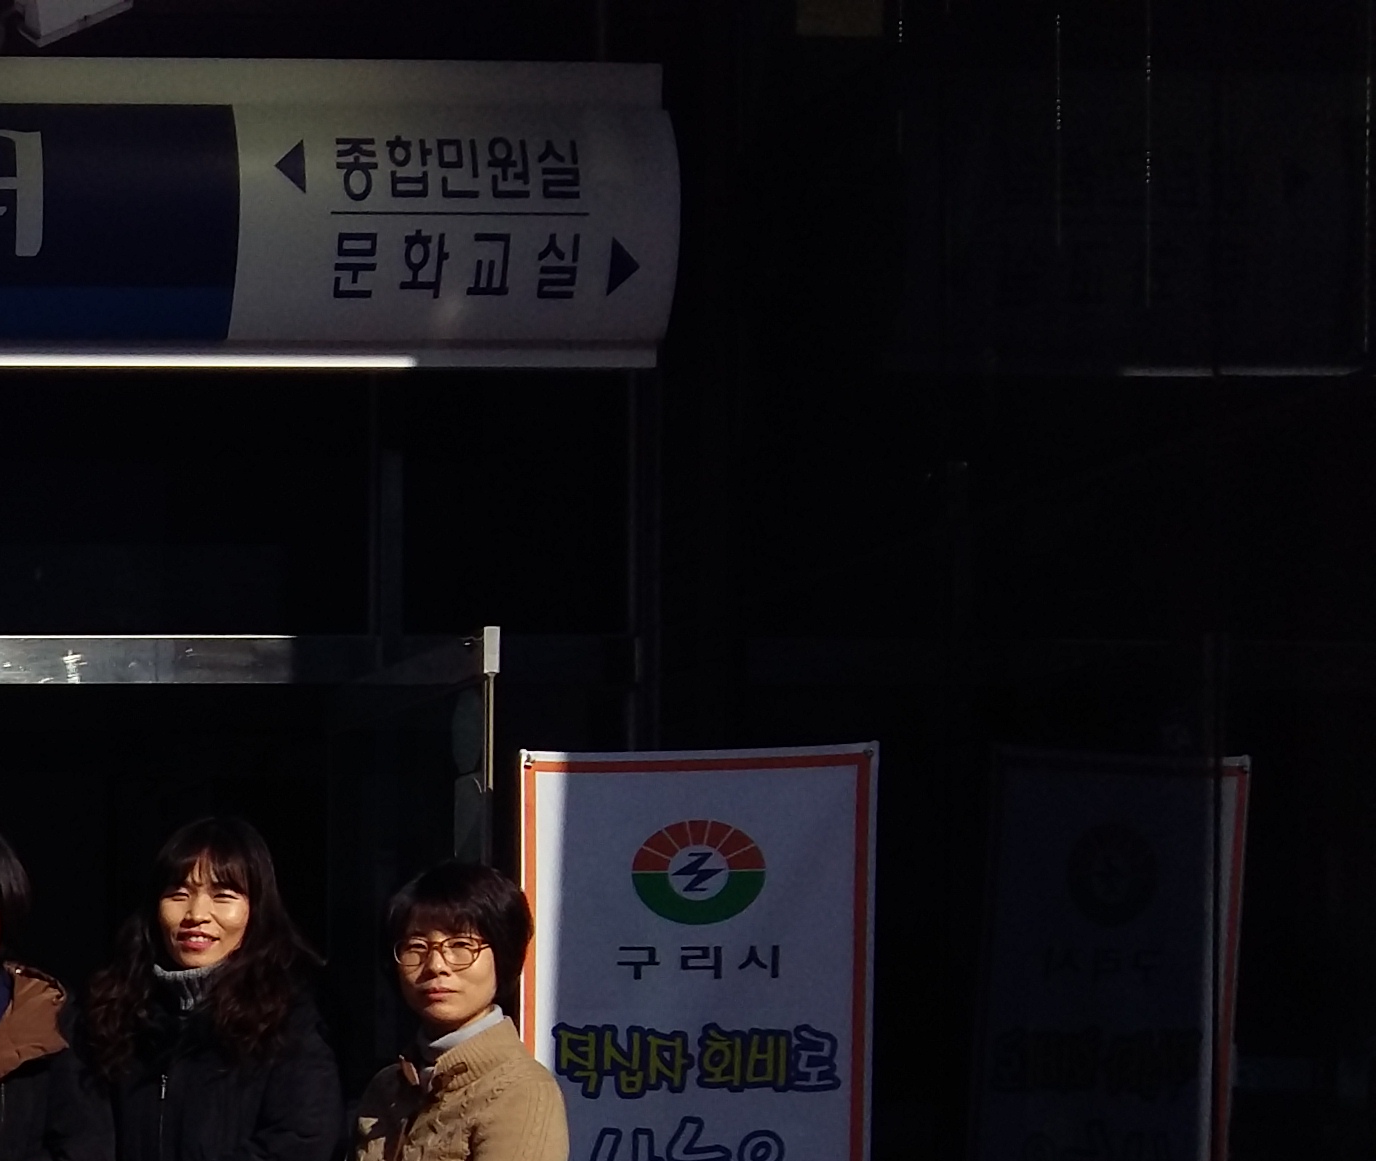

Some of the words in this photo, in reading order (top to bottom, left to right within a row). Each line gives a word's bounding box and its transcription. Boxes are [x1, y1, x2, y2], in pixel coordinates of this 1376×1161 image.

[335, 135, 581, 202] 종합민원실
[333, 228, 581, 300] 문화교실
[617, 944, 781, 980] 구리시
[553, 1021, 695, 1100] 적십자
[698, 1023, 842, 1093] 회비로
